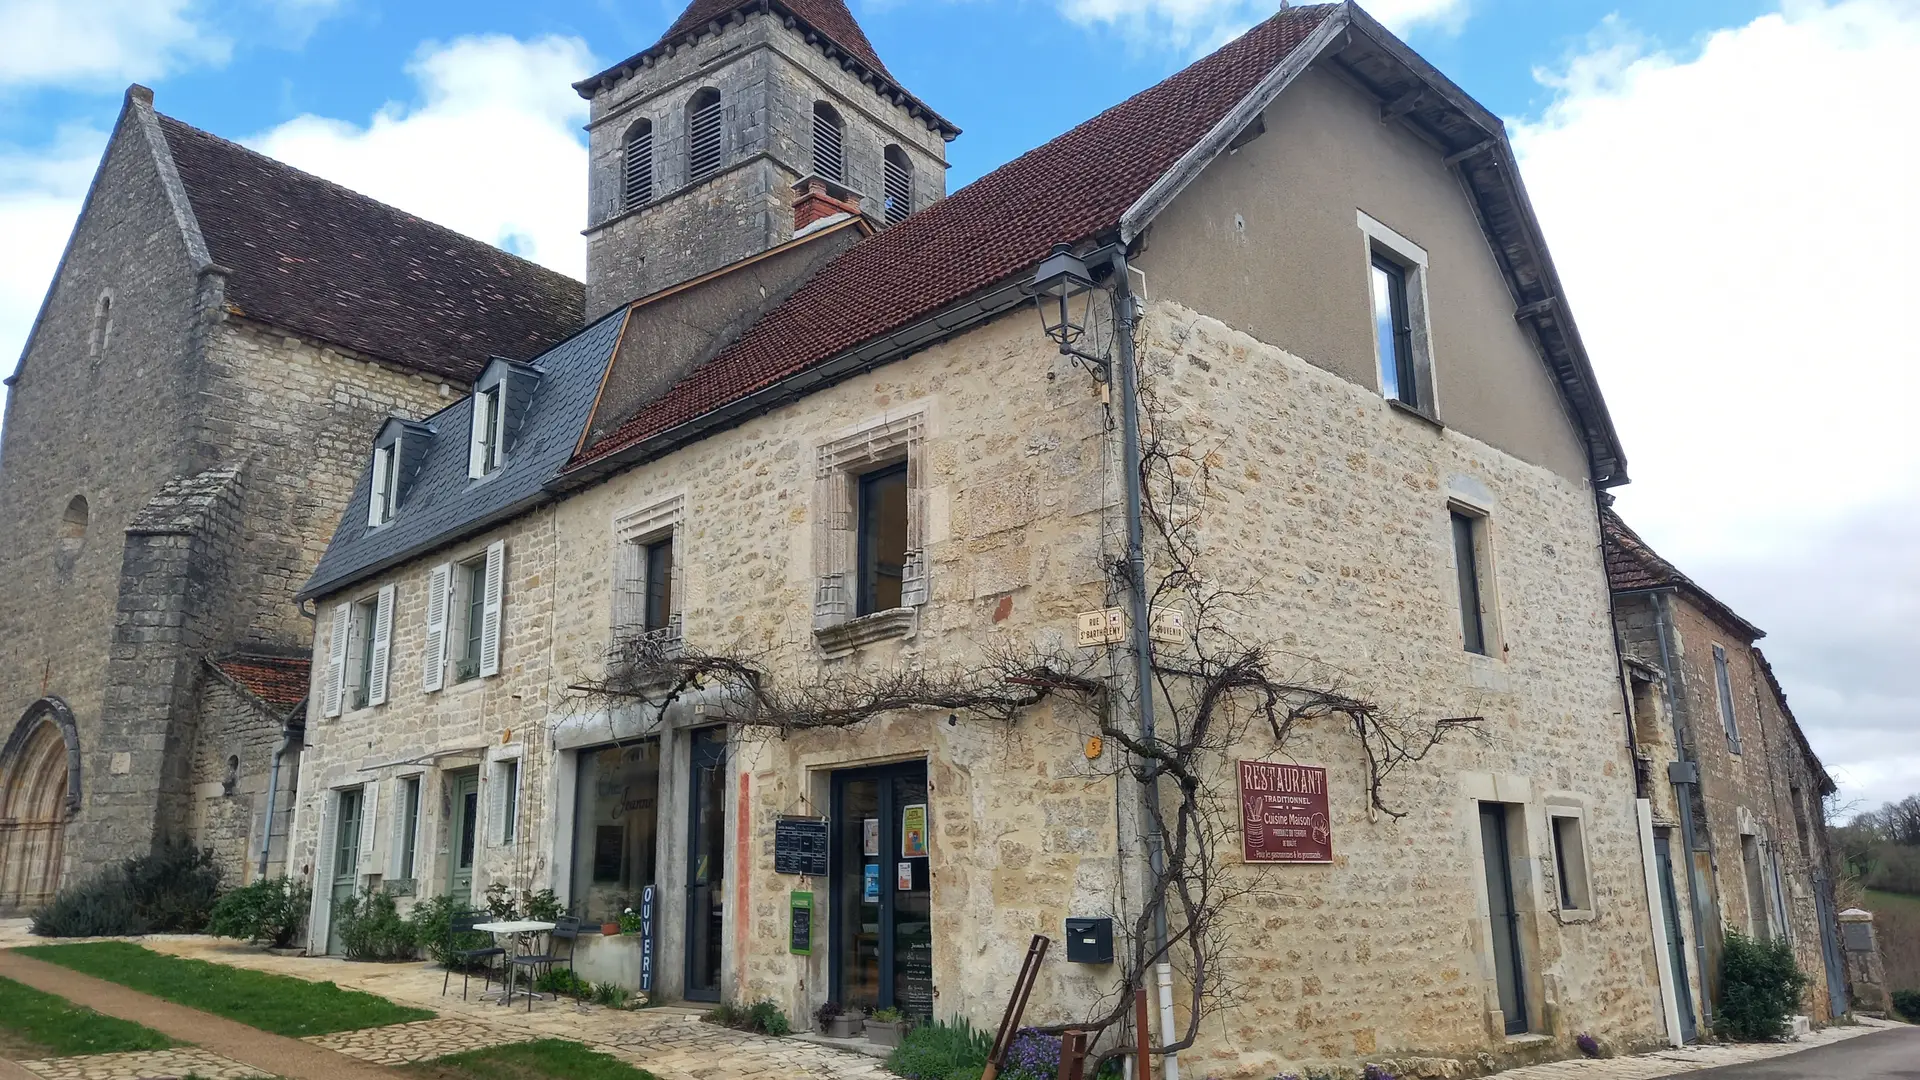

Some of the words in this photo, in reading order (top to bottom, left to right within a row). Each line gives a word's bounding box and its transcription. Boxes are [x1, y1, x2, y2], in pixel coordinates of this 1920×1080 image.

[1089, 617, 1100, 627] RUE
[1091, 741, 1097, 750] 5
[1244, 764, 1323, 794] RESTAURANT
[612, 785, 654, 820] Jeanne
[1263, 795, 1311, 805] TRADITIONNEL
[1263, 812, 1288, 825] Cuisine
[1288, 813, 1311, 826] Maison
[642, 887, 652, 989] OUVERT
